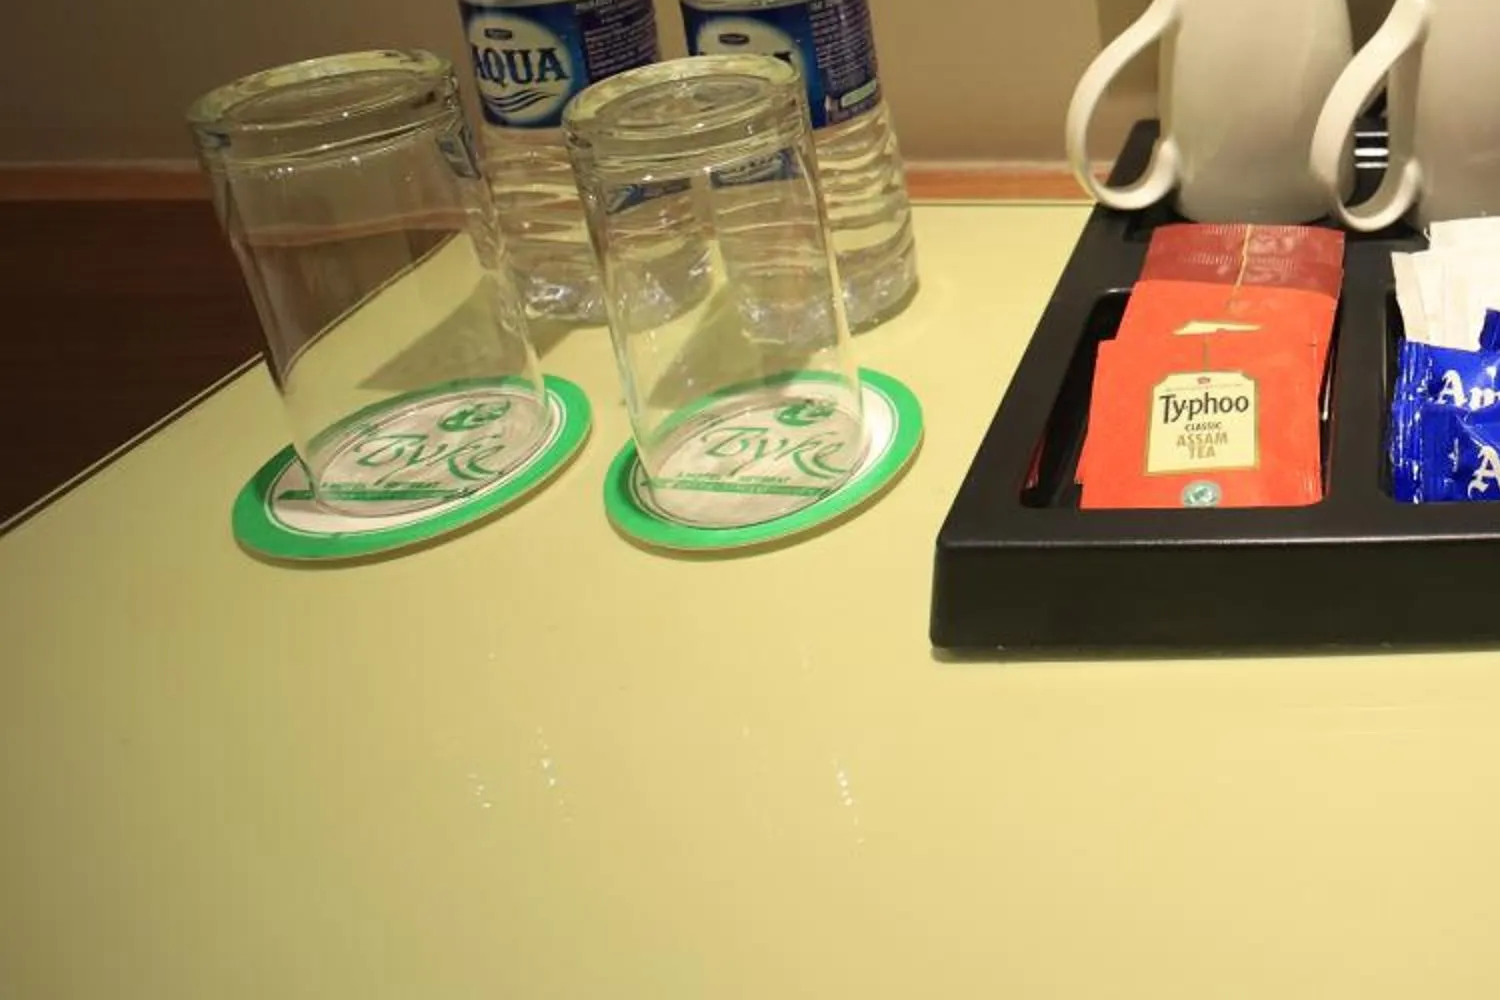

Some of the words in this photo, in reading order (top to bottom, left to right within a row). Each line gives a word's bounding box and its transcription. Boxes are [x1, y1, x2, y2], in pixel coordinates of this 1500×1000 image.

[1184, 421, 1222, 432] CLASSIC
[1176, 432, 1229, 447] ASSAM
[1188, 445, 1216, 459] TEA
